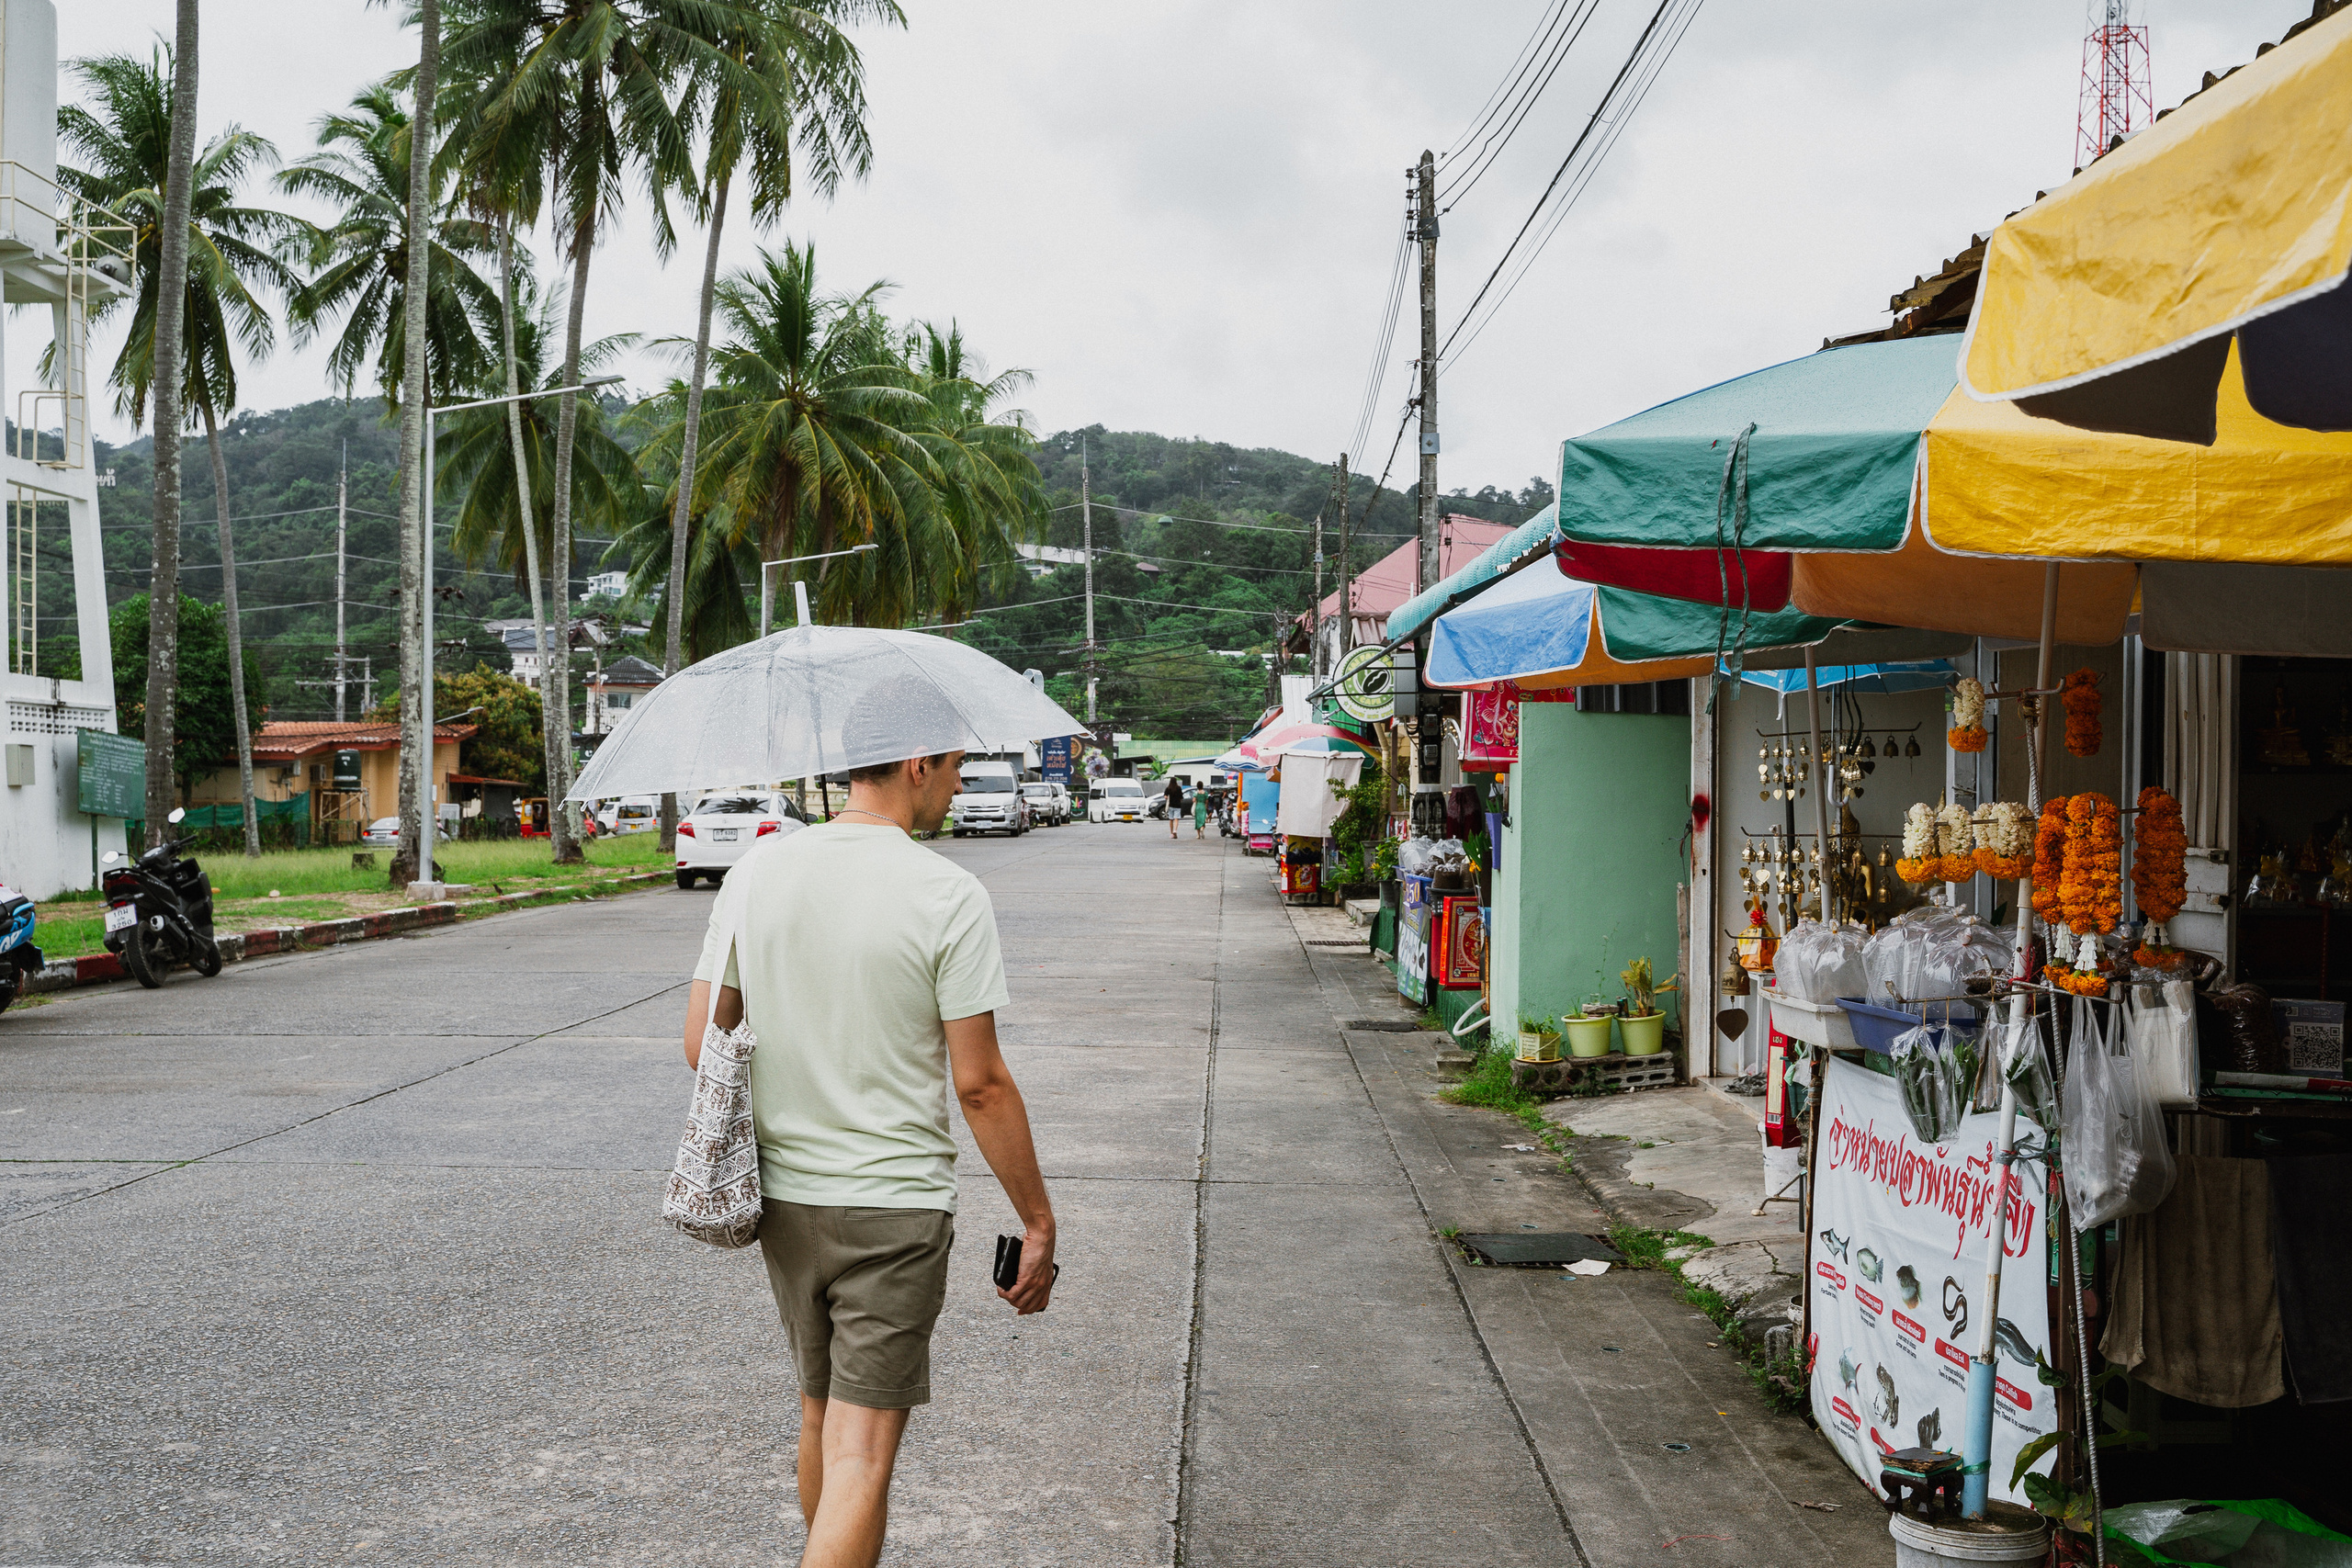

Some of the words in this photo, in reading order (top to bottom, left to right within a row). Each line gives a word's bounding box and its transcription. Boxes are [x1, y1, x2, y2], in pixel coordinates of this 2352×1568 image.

[1360, 696, 1382, 705] CAFE
[112, 919, 132, 930] 3250
[2005, 1383, 2018, 1402] Catfish
